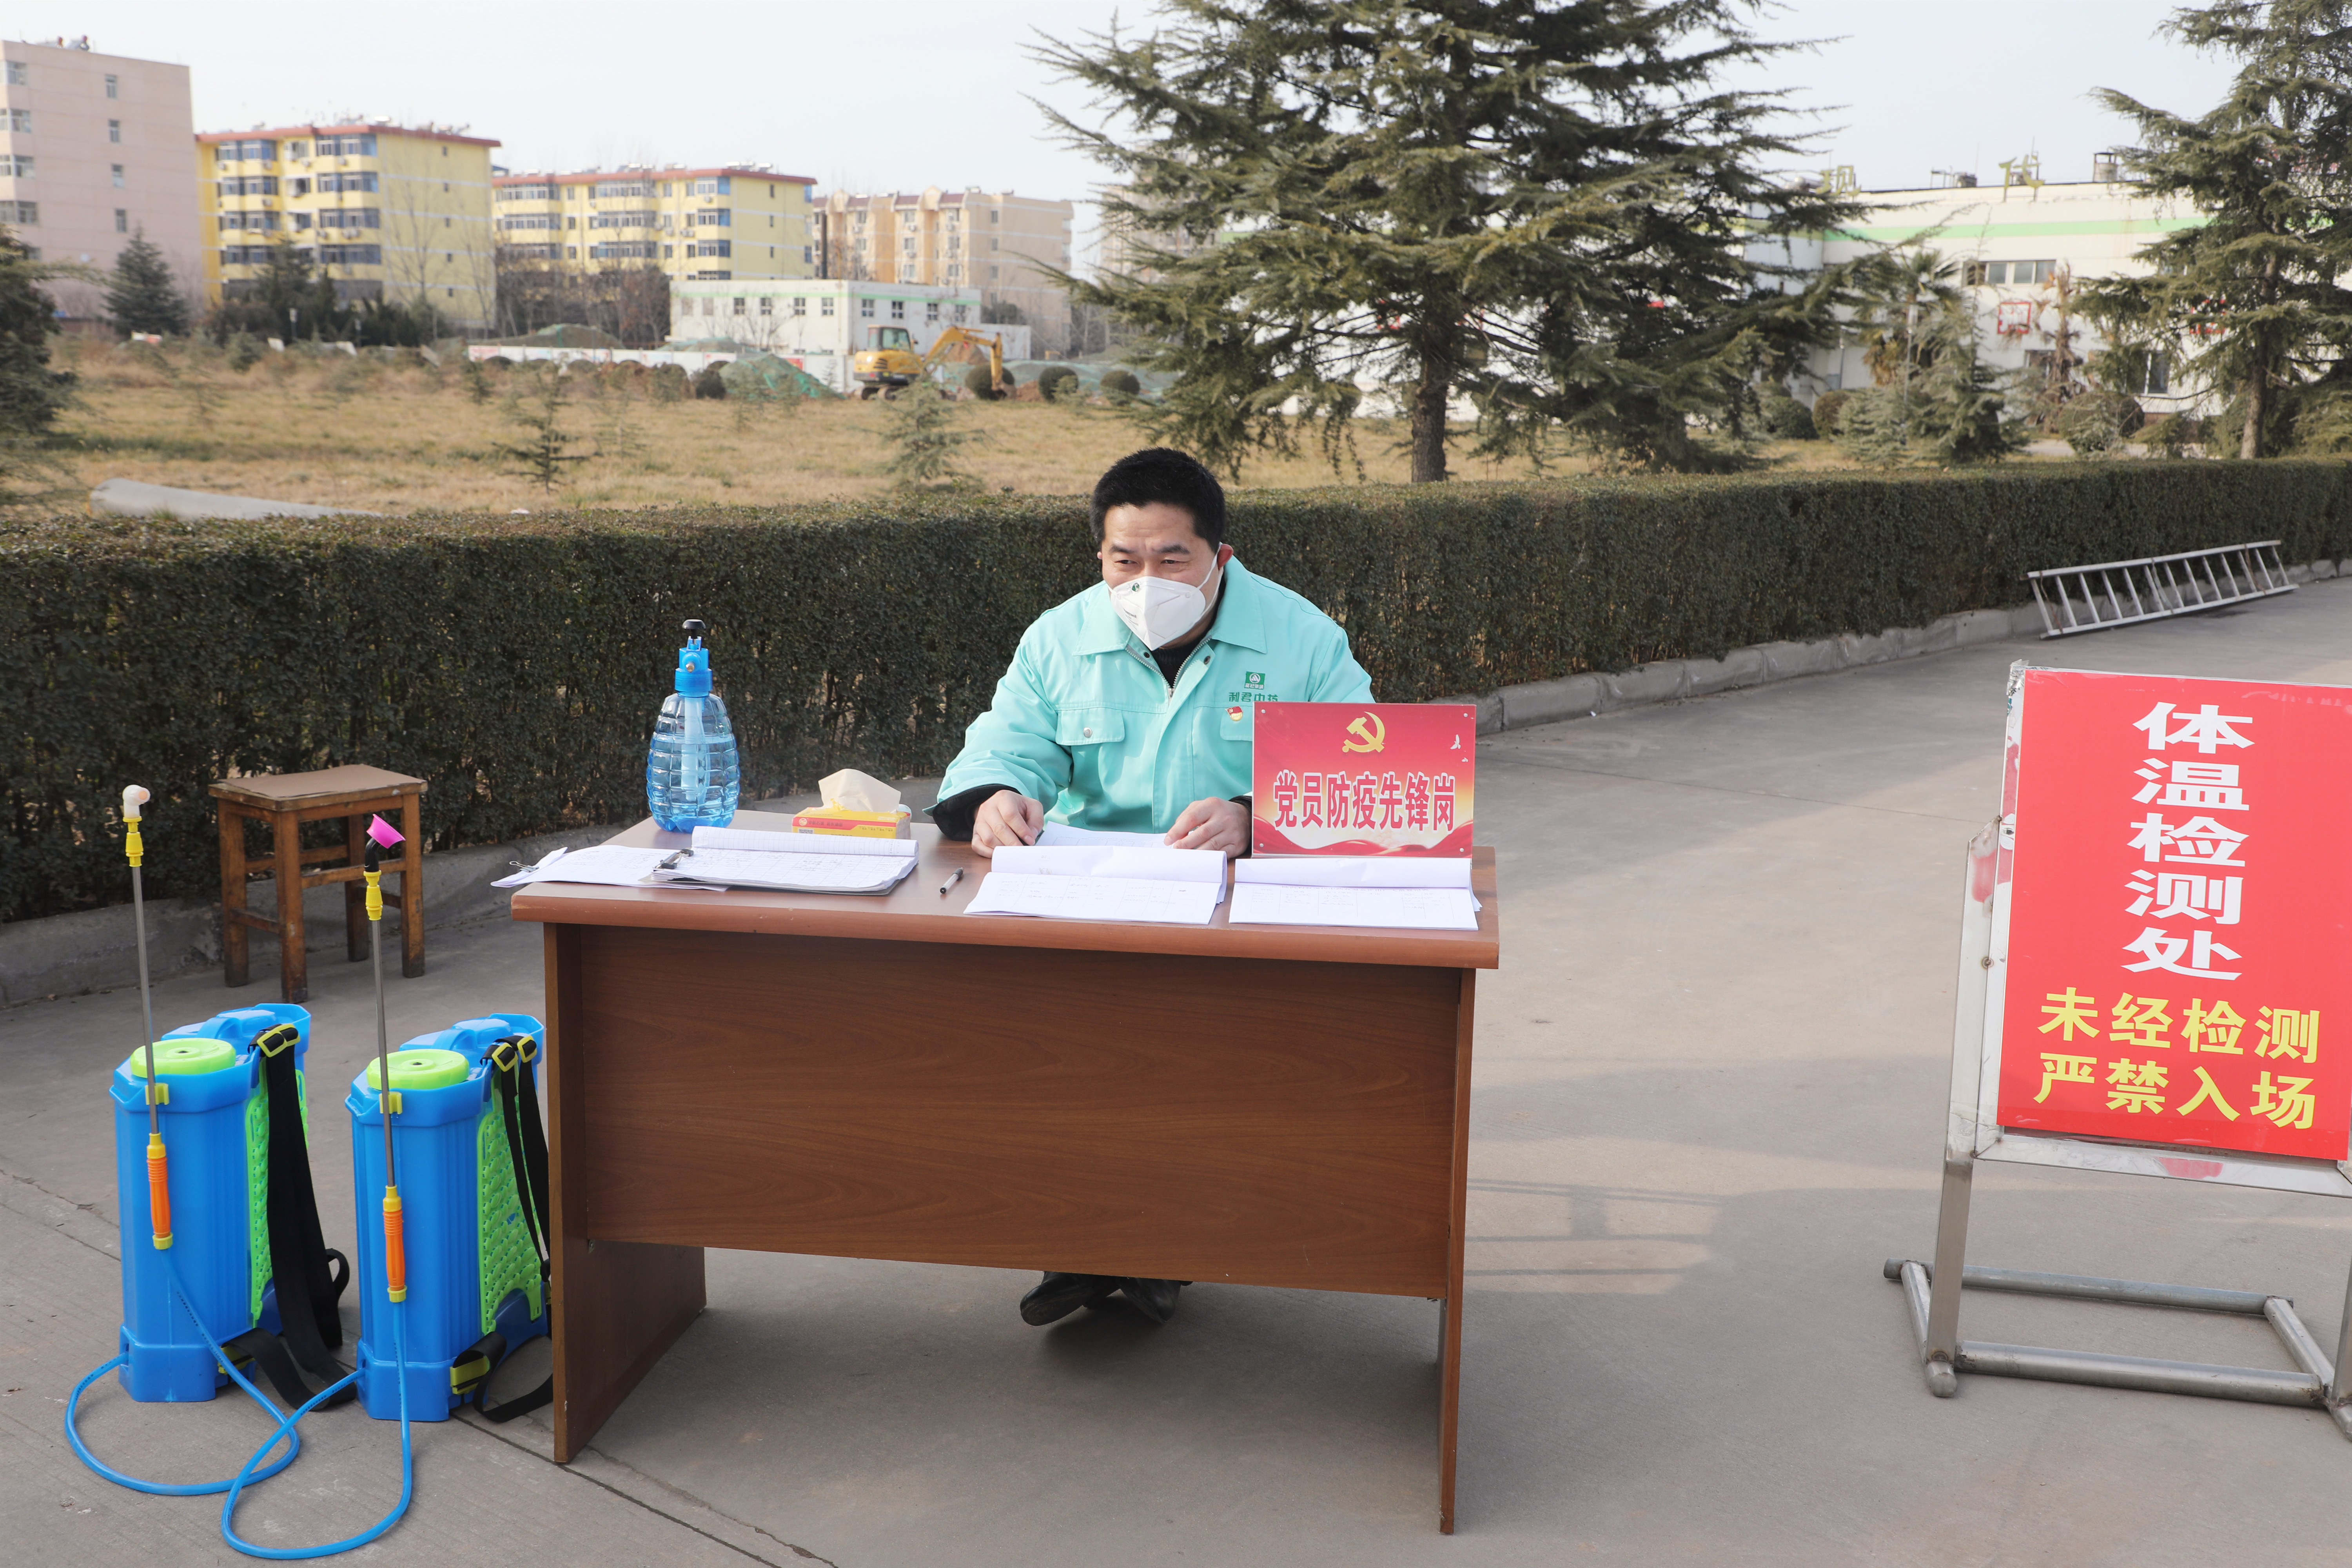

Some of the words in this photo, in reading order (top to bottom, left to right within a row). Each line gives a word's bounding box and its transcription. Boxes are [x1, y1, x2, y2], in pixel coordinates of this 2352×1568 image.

[1273, 769, 1456, 832] 党员防疫先锋岗
[2121, 701, 2255, 980] 体温检测处
[2037, 987, 2320, 1063] 未经检测
[2034, 1052, 2316, 1129] 严禁入场
